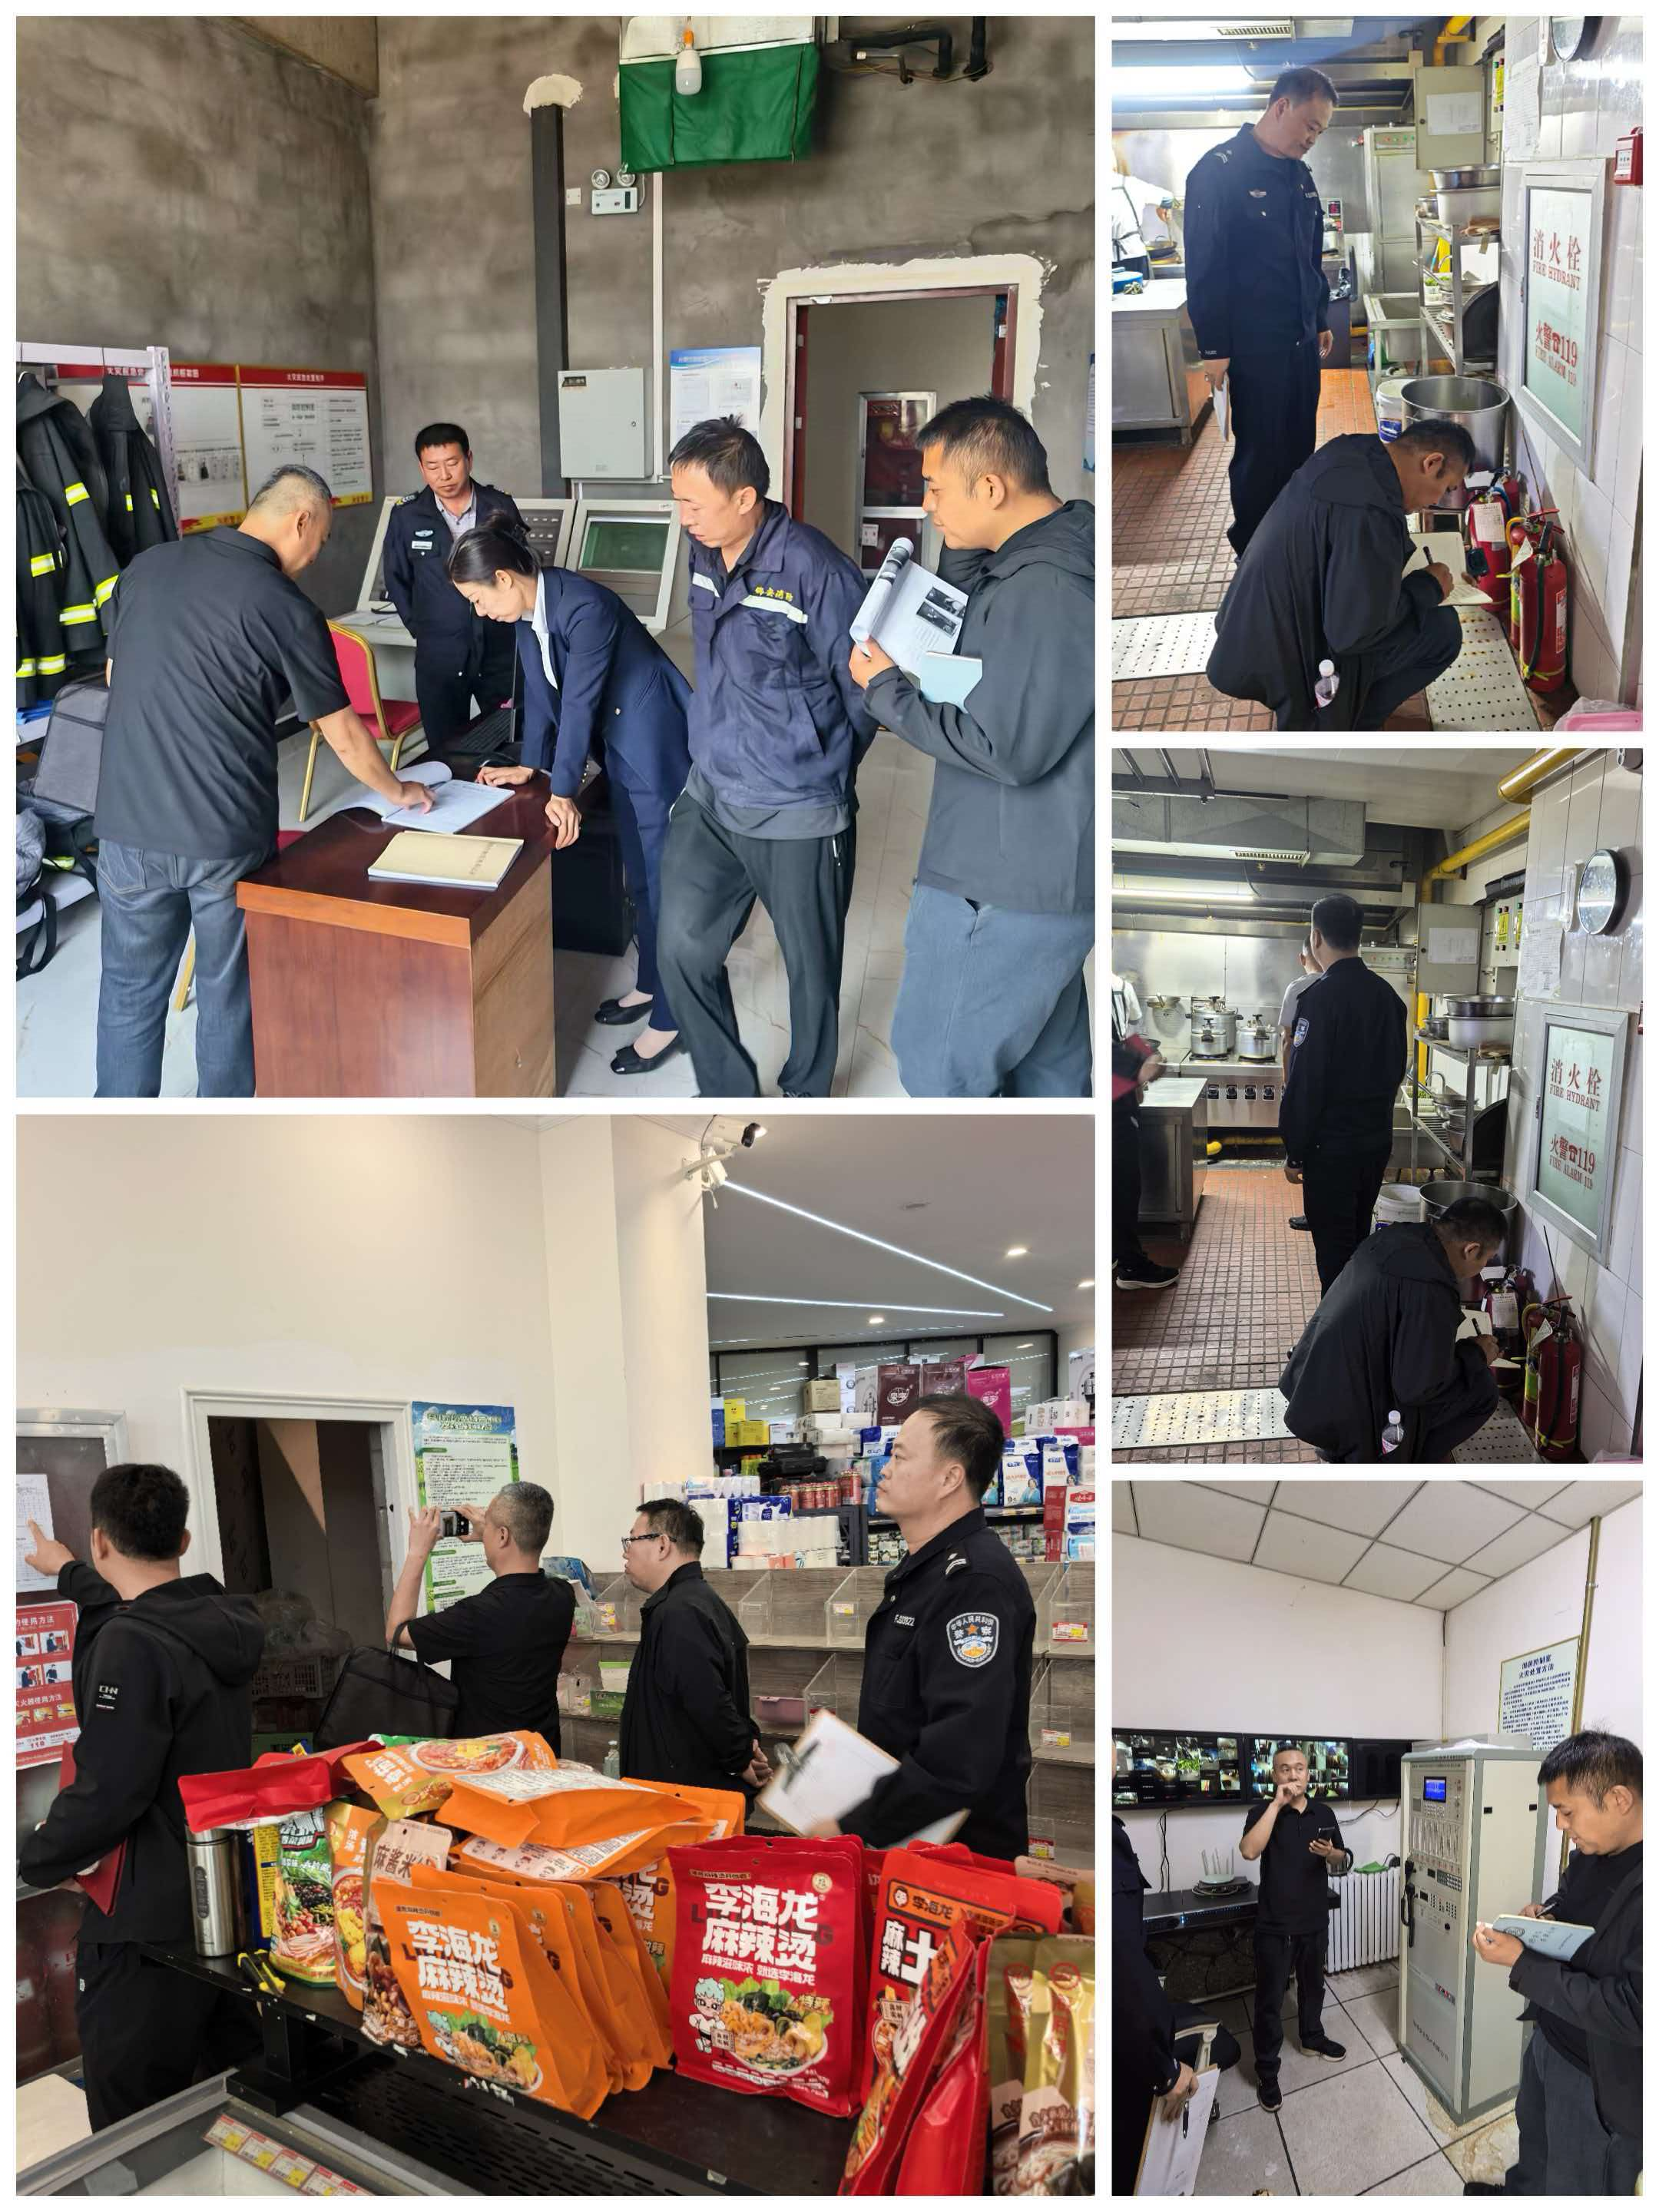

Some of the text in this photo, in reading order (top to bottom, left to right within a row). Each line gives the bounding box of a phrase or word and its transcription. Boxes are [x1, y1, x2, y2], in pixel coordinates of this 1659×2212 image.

[1533, 229, 1581, 272] 消火栓
[1548, 265, 1581, 291] HYDRANT
[1550, 1058, 1602, 1097] 消火栓
[1549, 1083, 1601, 1112] FIRE HYDRANT
[1548, 1154, 1594, 1190] FIRE ALARM 119
[1518, 1663, 1555, 1679] 火灾处置方法
[704, 1883, 819, 1932] 李海龙
[912, 1894, 953, 1920] 李海龙
[406, 1919, 502, 1976] 李海龙
[702, 1918, 817, 1972] 麻辣烫
[417, 1954, 509, 2013] 麻辣烫
[757, 1965, 816, 1987] 就选李海龙
